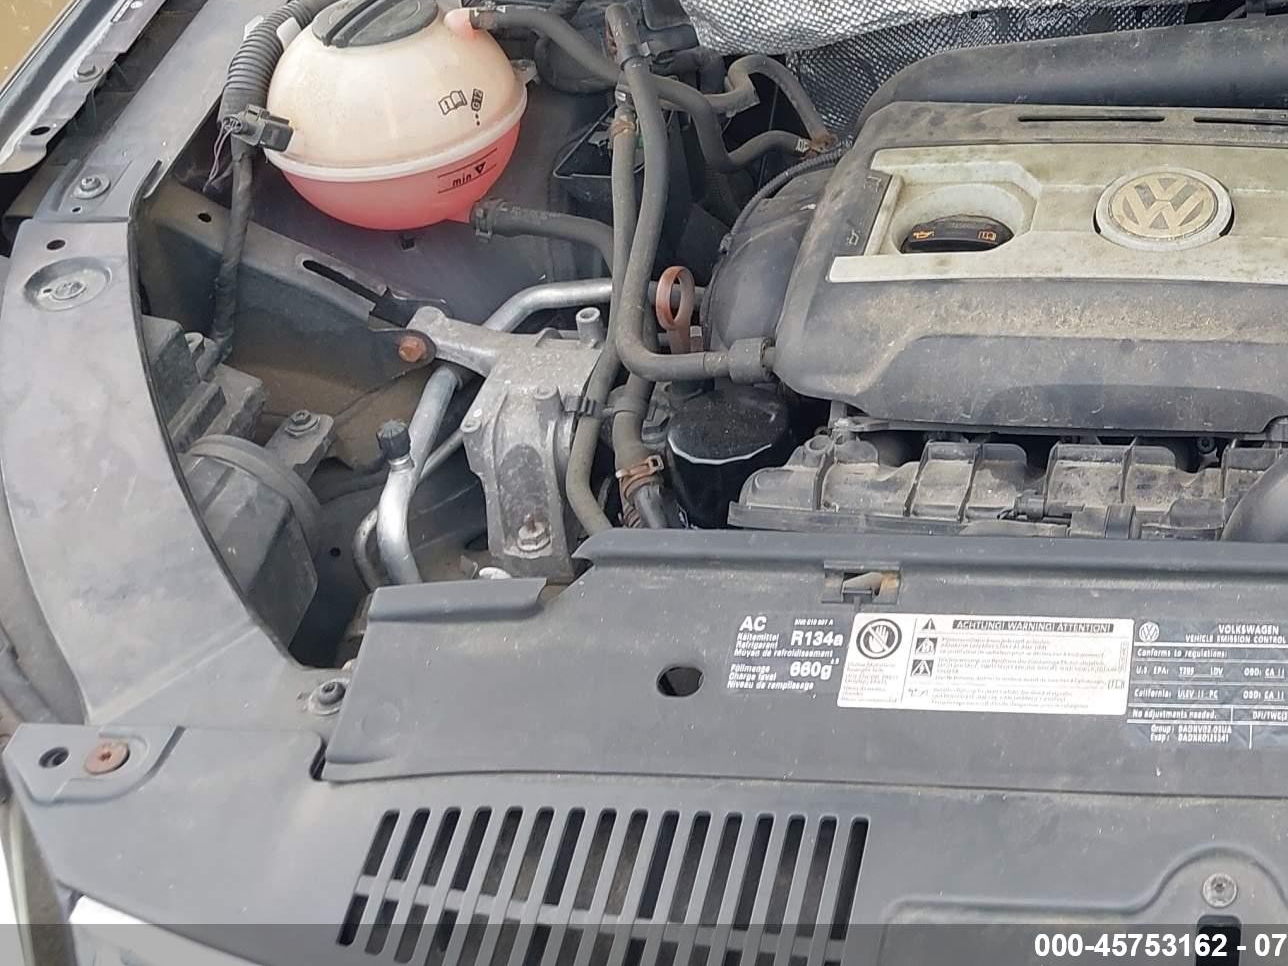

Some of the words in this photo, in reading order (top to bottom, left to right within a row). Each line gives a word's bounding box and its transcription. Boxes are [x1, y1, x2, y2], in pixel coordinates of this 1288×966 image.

[471, 89, 483, 111] G12
[452, 173, 472, 187] min
[739, 616, 767, 631] AC
[956, 621, 1005, 630] ACHTUNG!
[1007, 621, 1054, 632] WARNING!
[1057, 622, 1111, 633] ATTENTION!
[1218, 624, 1279, 635] VOLKSWAGEN
[791, 630, 843, 646] R134a
[1185, 634, 1213, 643] VEHICLE
[1217, 634, 1250, 643] EMISSION
[1253, 635, 1286, 644] CONTROL
[735, 641, 778, 650] Refrigerant
[734, 649, 760, 658] Moyen
[762, 649, 772, 657] de
[773, 649, 833, 658] refroidissement
[1137, 648, 1171, 657] Conforms
[1174, 649, 1182, 657] to
[1184, 649, 1227, 659] regulations:
[790, 661, 832, 680] 660g
[1153, 666, 1169, 674] EPA:
[1210, 666, 1224, 676] LDV
[1264, 668, 1275, 677] CA
[728, 673, 757, 682] Charge
[758, 673, 777, 681] level
[727, 681, 754, 689] Niveau
[756, 681, 766, 689] de
[767, 681, 814, 690] remplissage
[1134, 688, 1172, 698] California:
[1177, 689, 1195, 699] ULEV
[1209, 690, 1219, 699] PC
[1264, 690, 1274, 699] CA
[1132, 709, 1143, 718] No
[1144, 709, 1187, 719] adjustments
[1189, 710, 1217, 719] needed.
